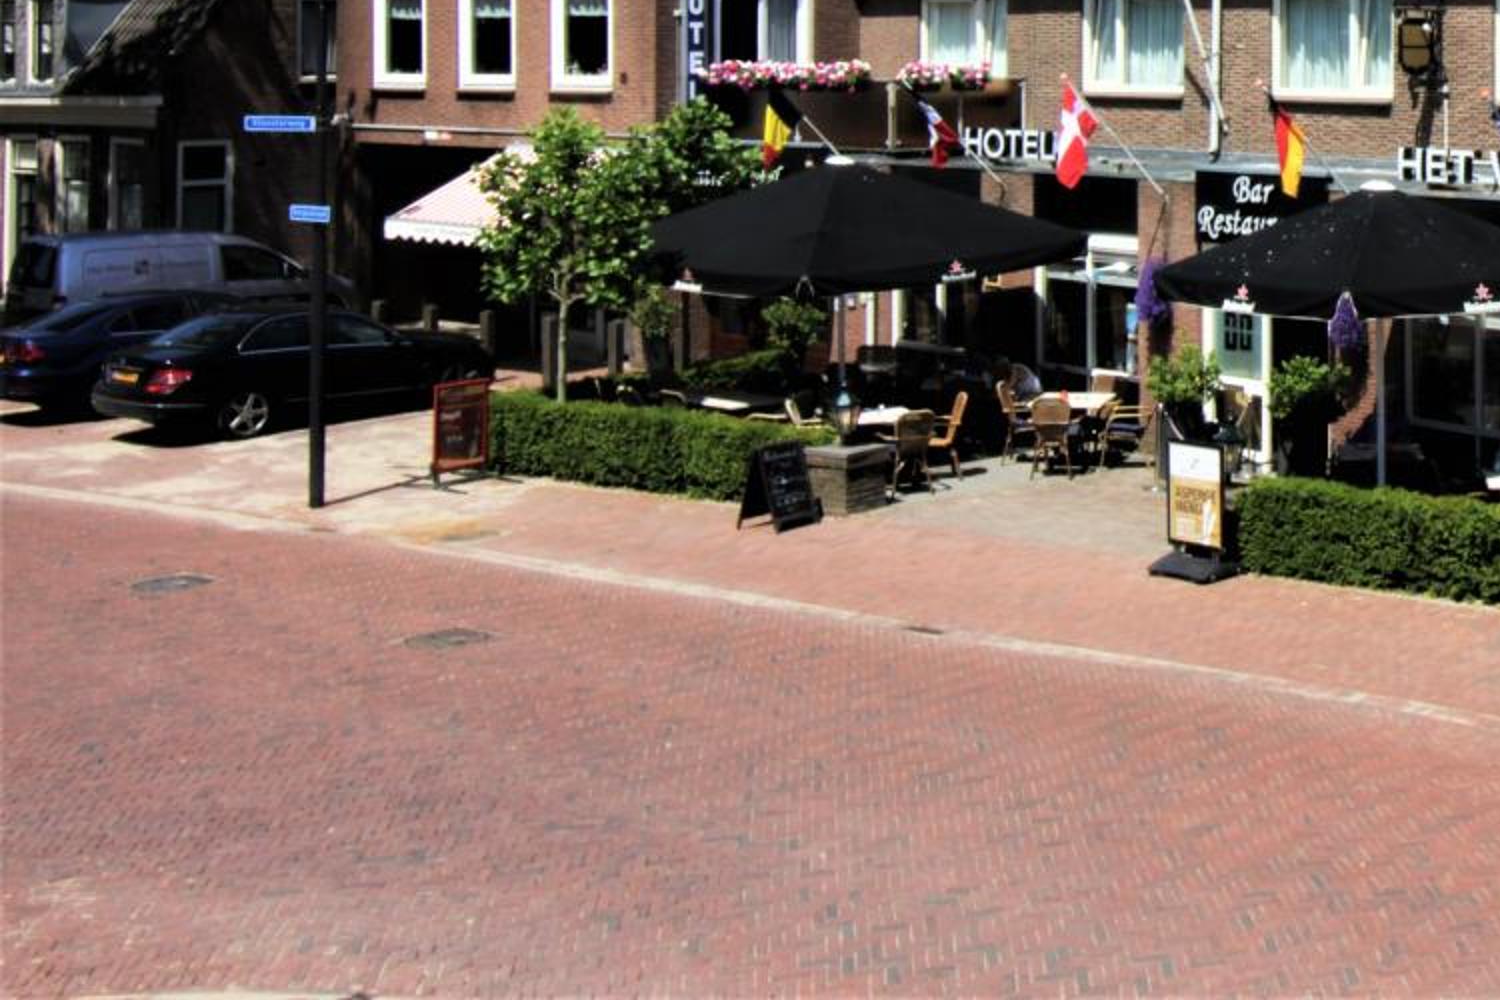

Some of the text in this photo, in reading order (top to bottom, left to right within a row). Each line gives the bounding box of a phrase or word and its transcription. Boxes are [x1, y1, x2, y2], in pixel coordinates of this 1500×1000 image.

[964, 127, 1057, 161] HOTEL
[1397, 146, 1475, 184] HET
[1232, 175, 1275, 204] Bar
